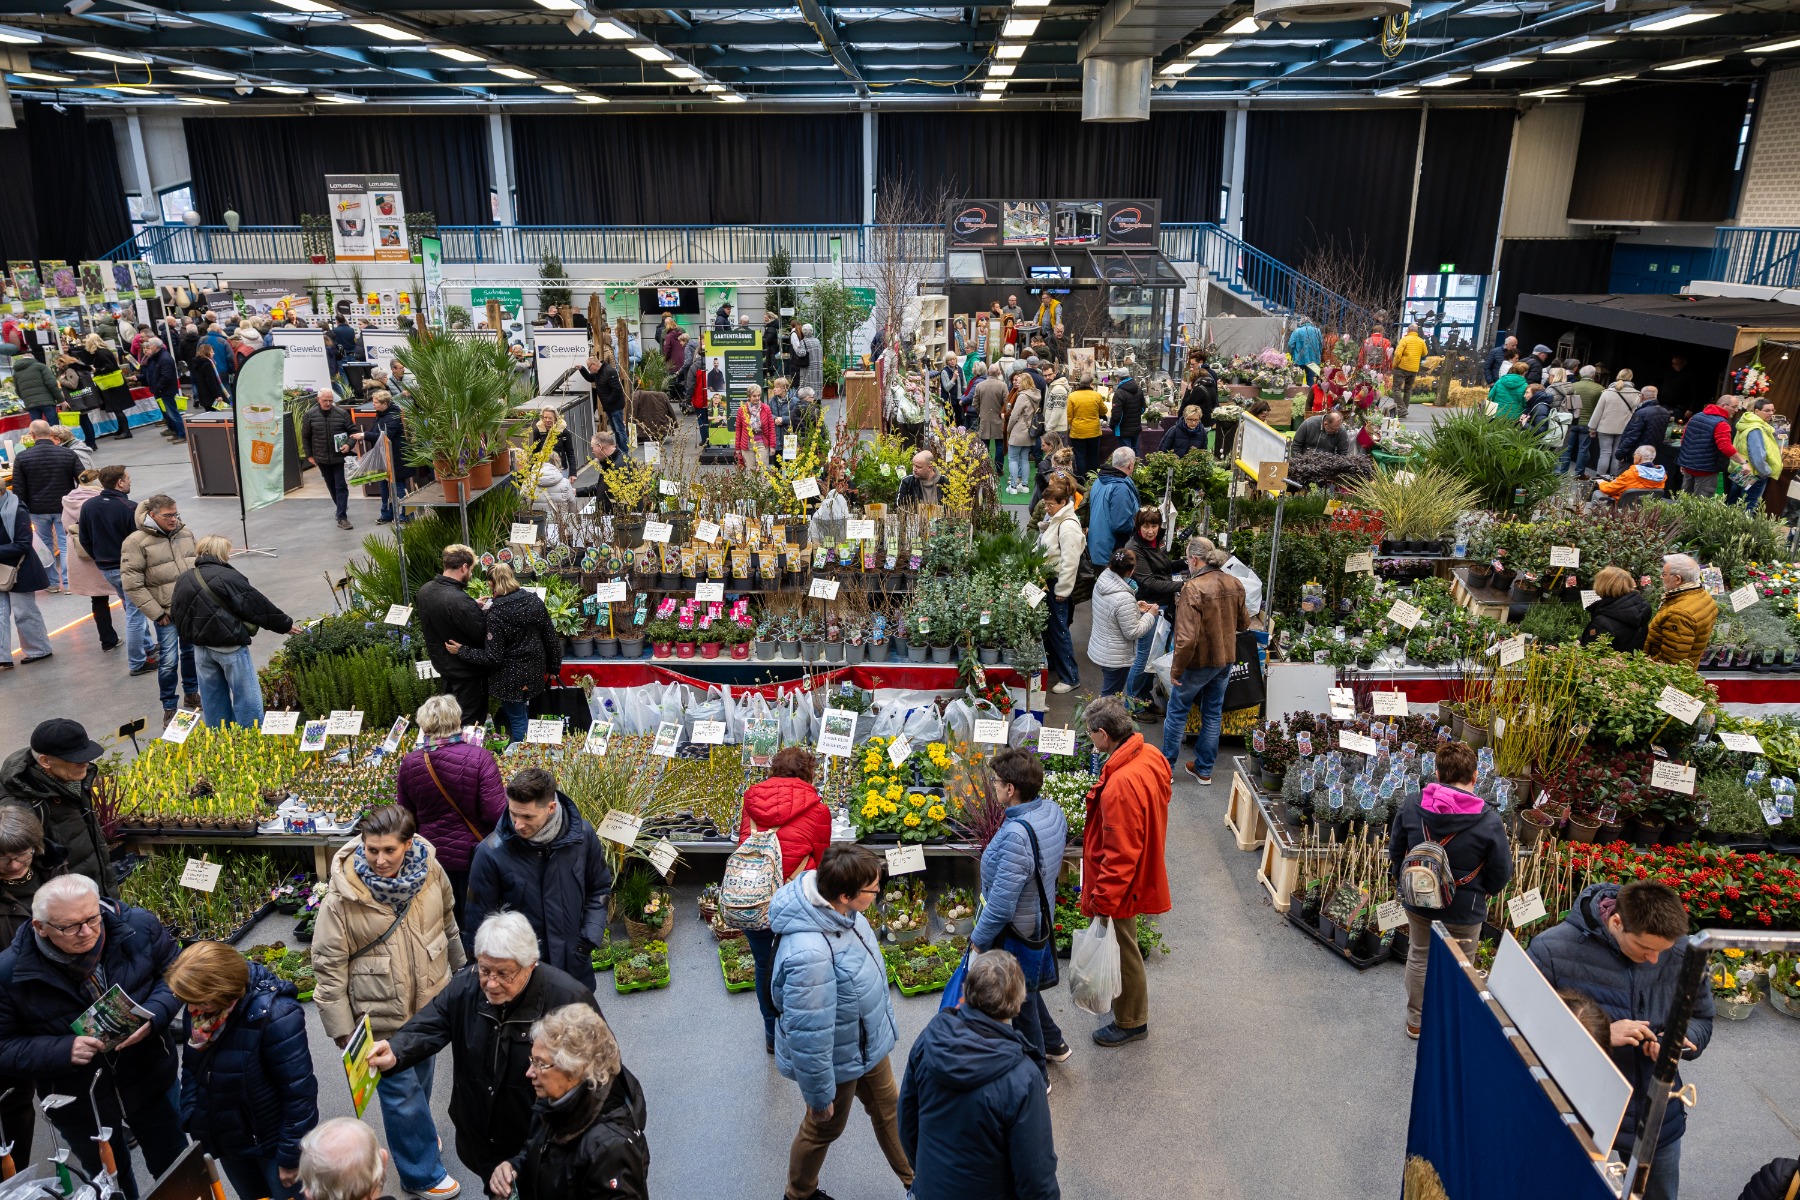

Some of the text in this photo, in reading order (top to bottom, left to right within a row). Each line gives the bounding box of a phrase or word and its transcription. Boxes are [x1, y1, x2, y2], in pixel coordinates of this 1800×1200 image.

[290, 344, 323, 354] Geweko
[550, 345, 586, 353] Geweko
[1269, 465, 1278, 478] 2
